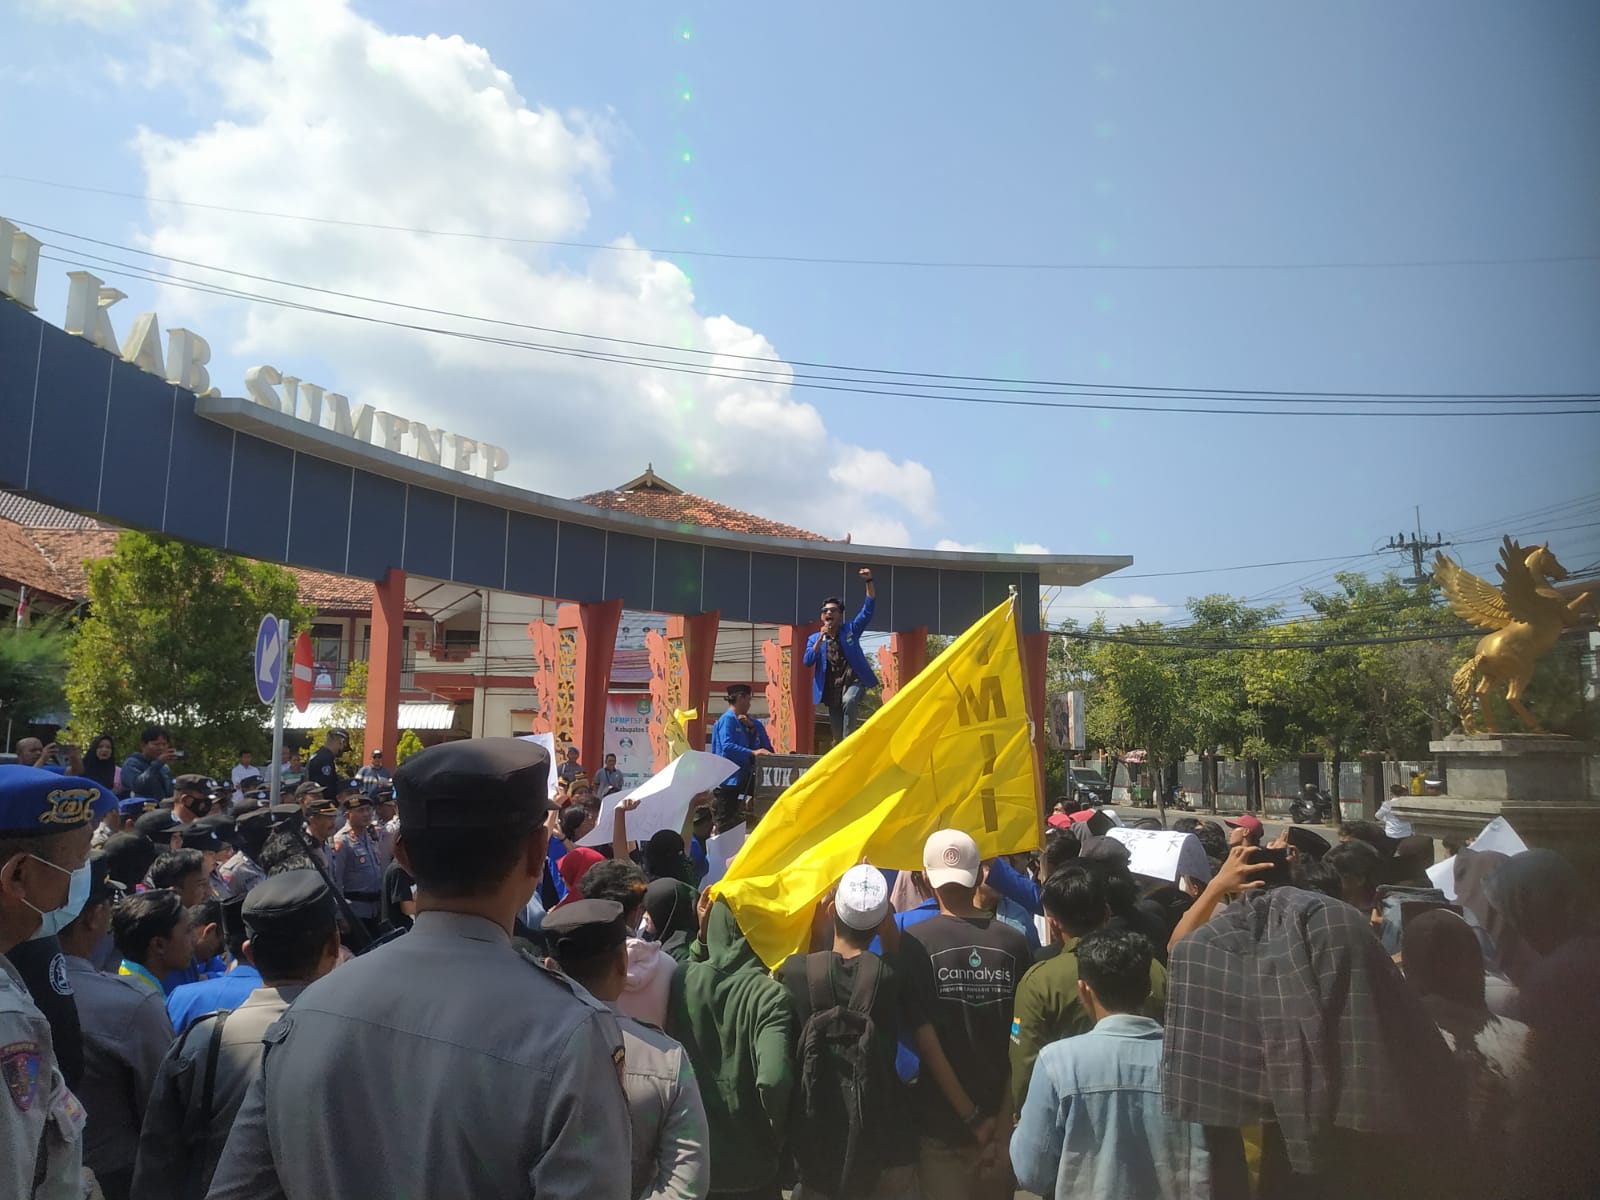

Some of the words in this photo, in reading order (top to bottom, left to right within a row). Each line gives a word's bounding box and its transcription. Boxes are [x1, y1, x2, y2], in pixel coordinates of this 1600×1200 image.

[64, 270, 221, 398] KAB.
[245, 365, 510, 482] SUMENEP
[938, 967, 1011, 983] Cannalysis
